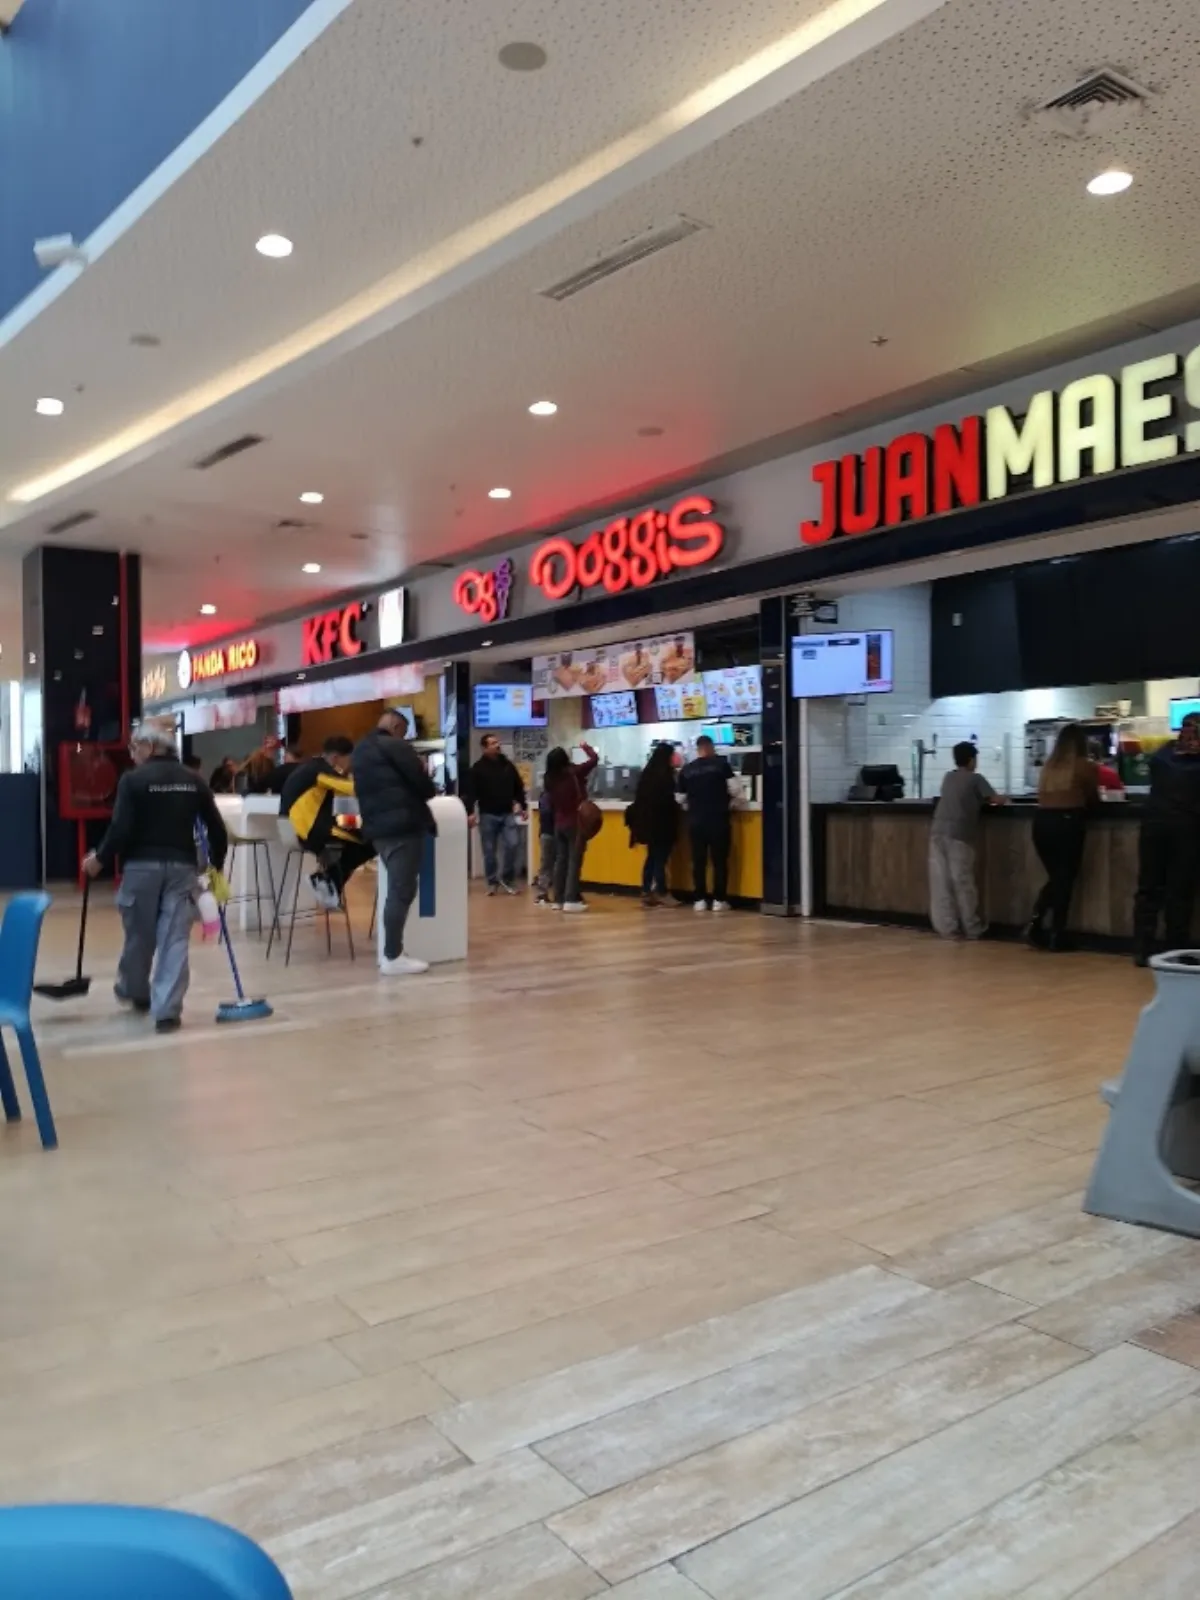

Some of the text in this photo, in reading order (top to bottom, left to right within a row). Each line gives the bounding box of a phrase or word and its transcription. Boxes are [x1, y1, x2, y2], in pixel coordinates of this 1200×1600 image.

[302, 600, 361, 666] KFC
[192, 639, 257, 682] PANDA RICO
